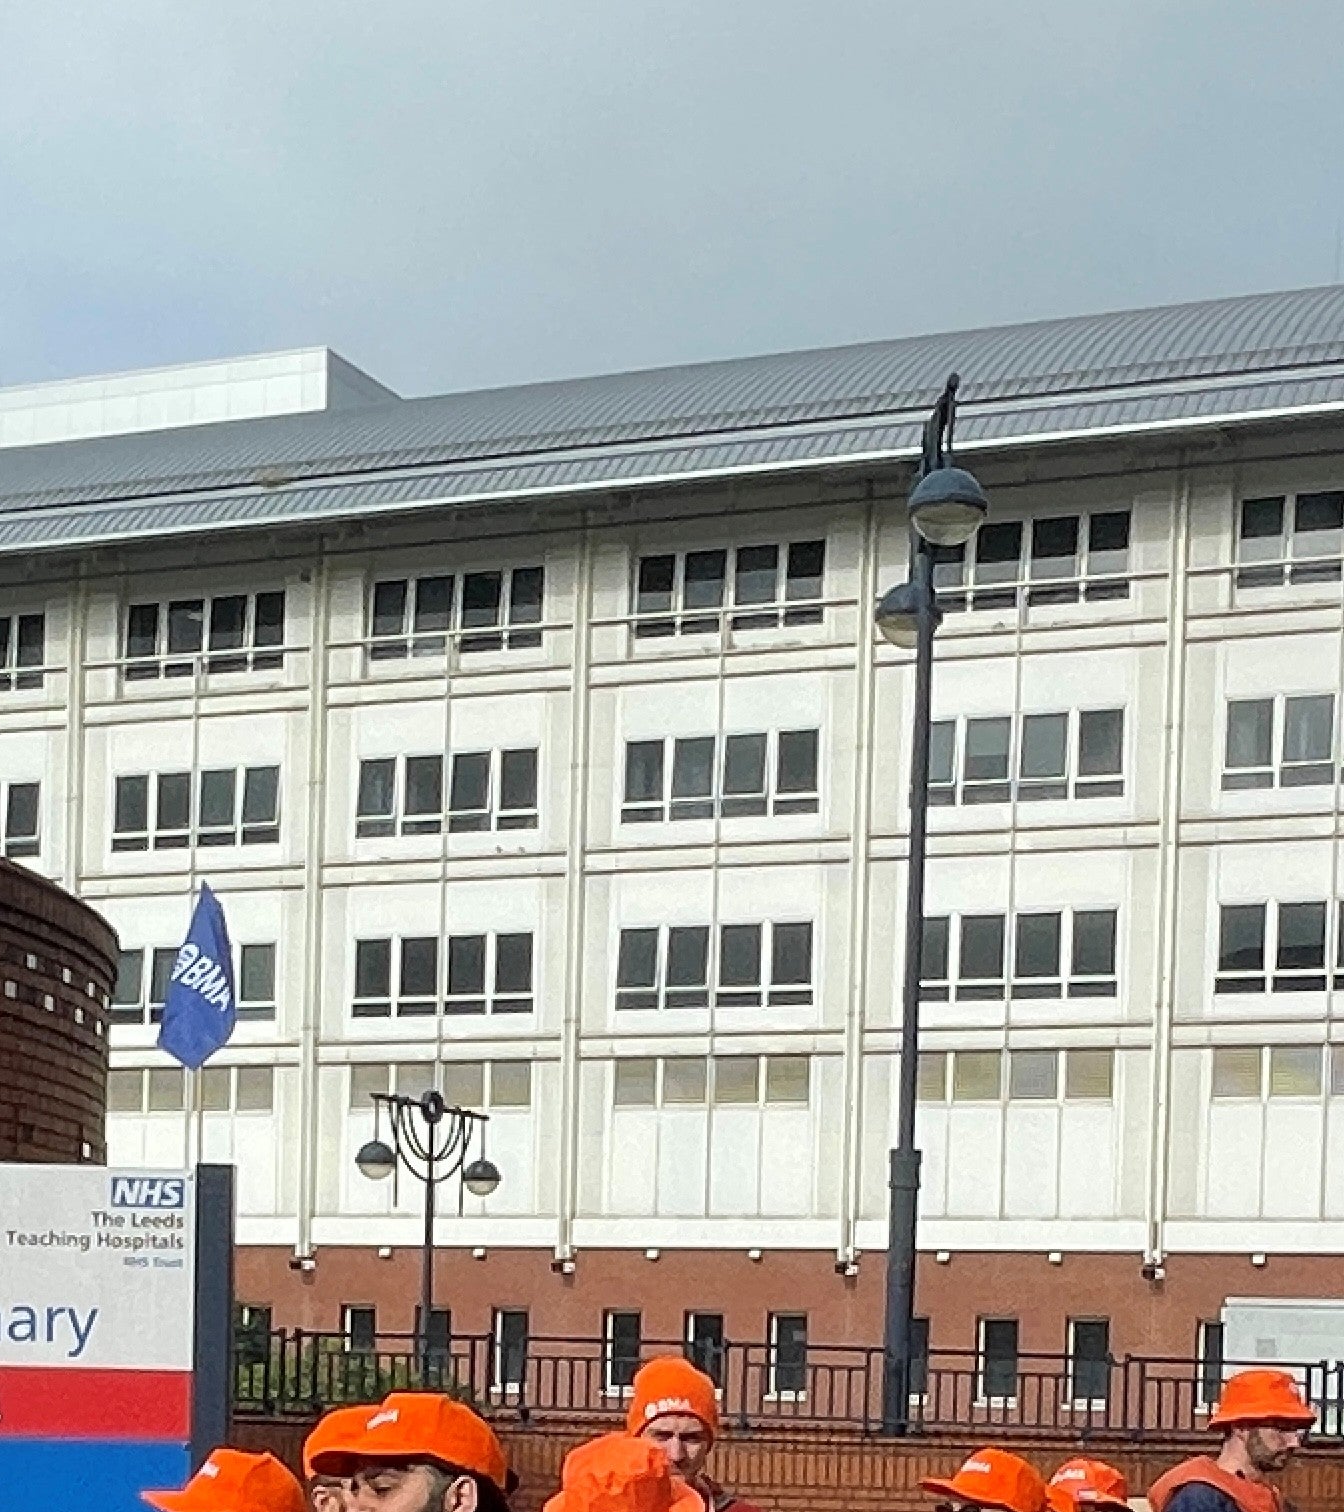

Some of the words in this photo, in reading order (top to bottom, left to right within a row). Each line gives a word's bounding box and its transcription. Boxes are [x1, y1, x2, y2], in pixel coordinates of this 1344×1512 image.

[181, 955, 230, 1012] BMA
[113, 1179, 183, 1206] NHS
[91, 1211, 126, 1228] The
[131, 1213, 184, 1228] Leeds
[6, 1230, 91, 1252] Teaching
[97, 1233, 184, 1251] Hospitals
